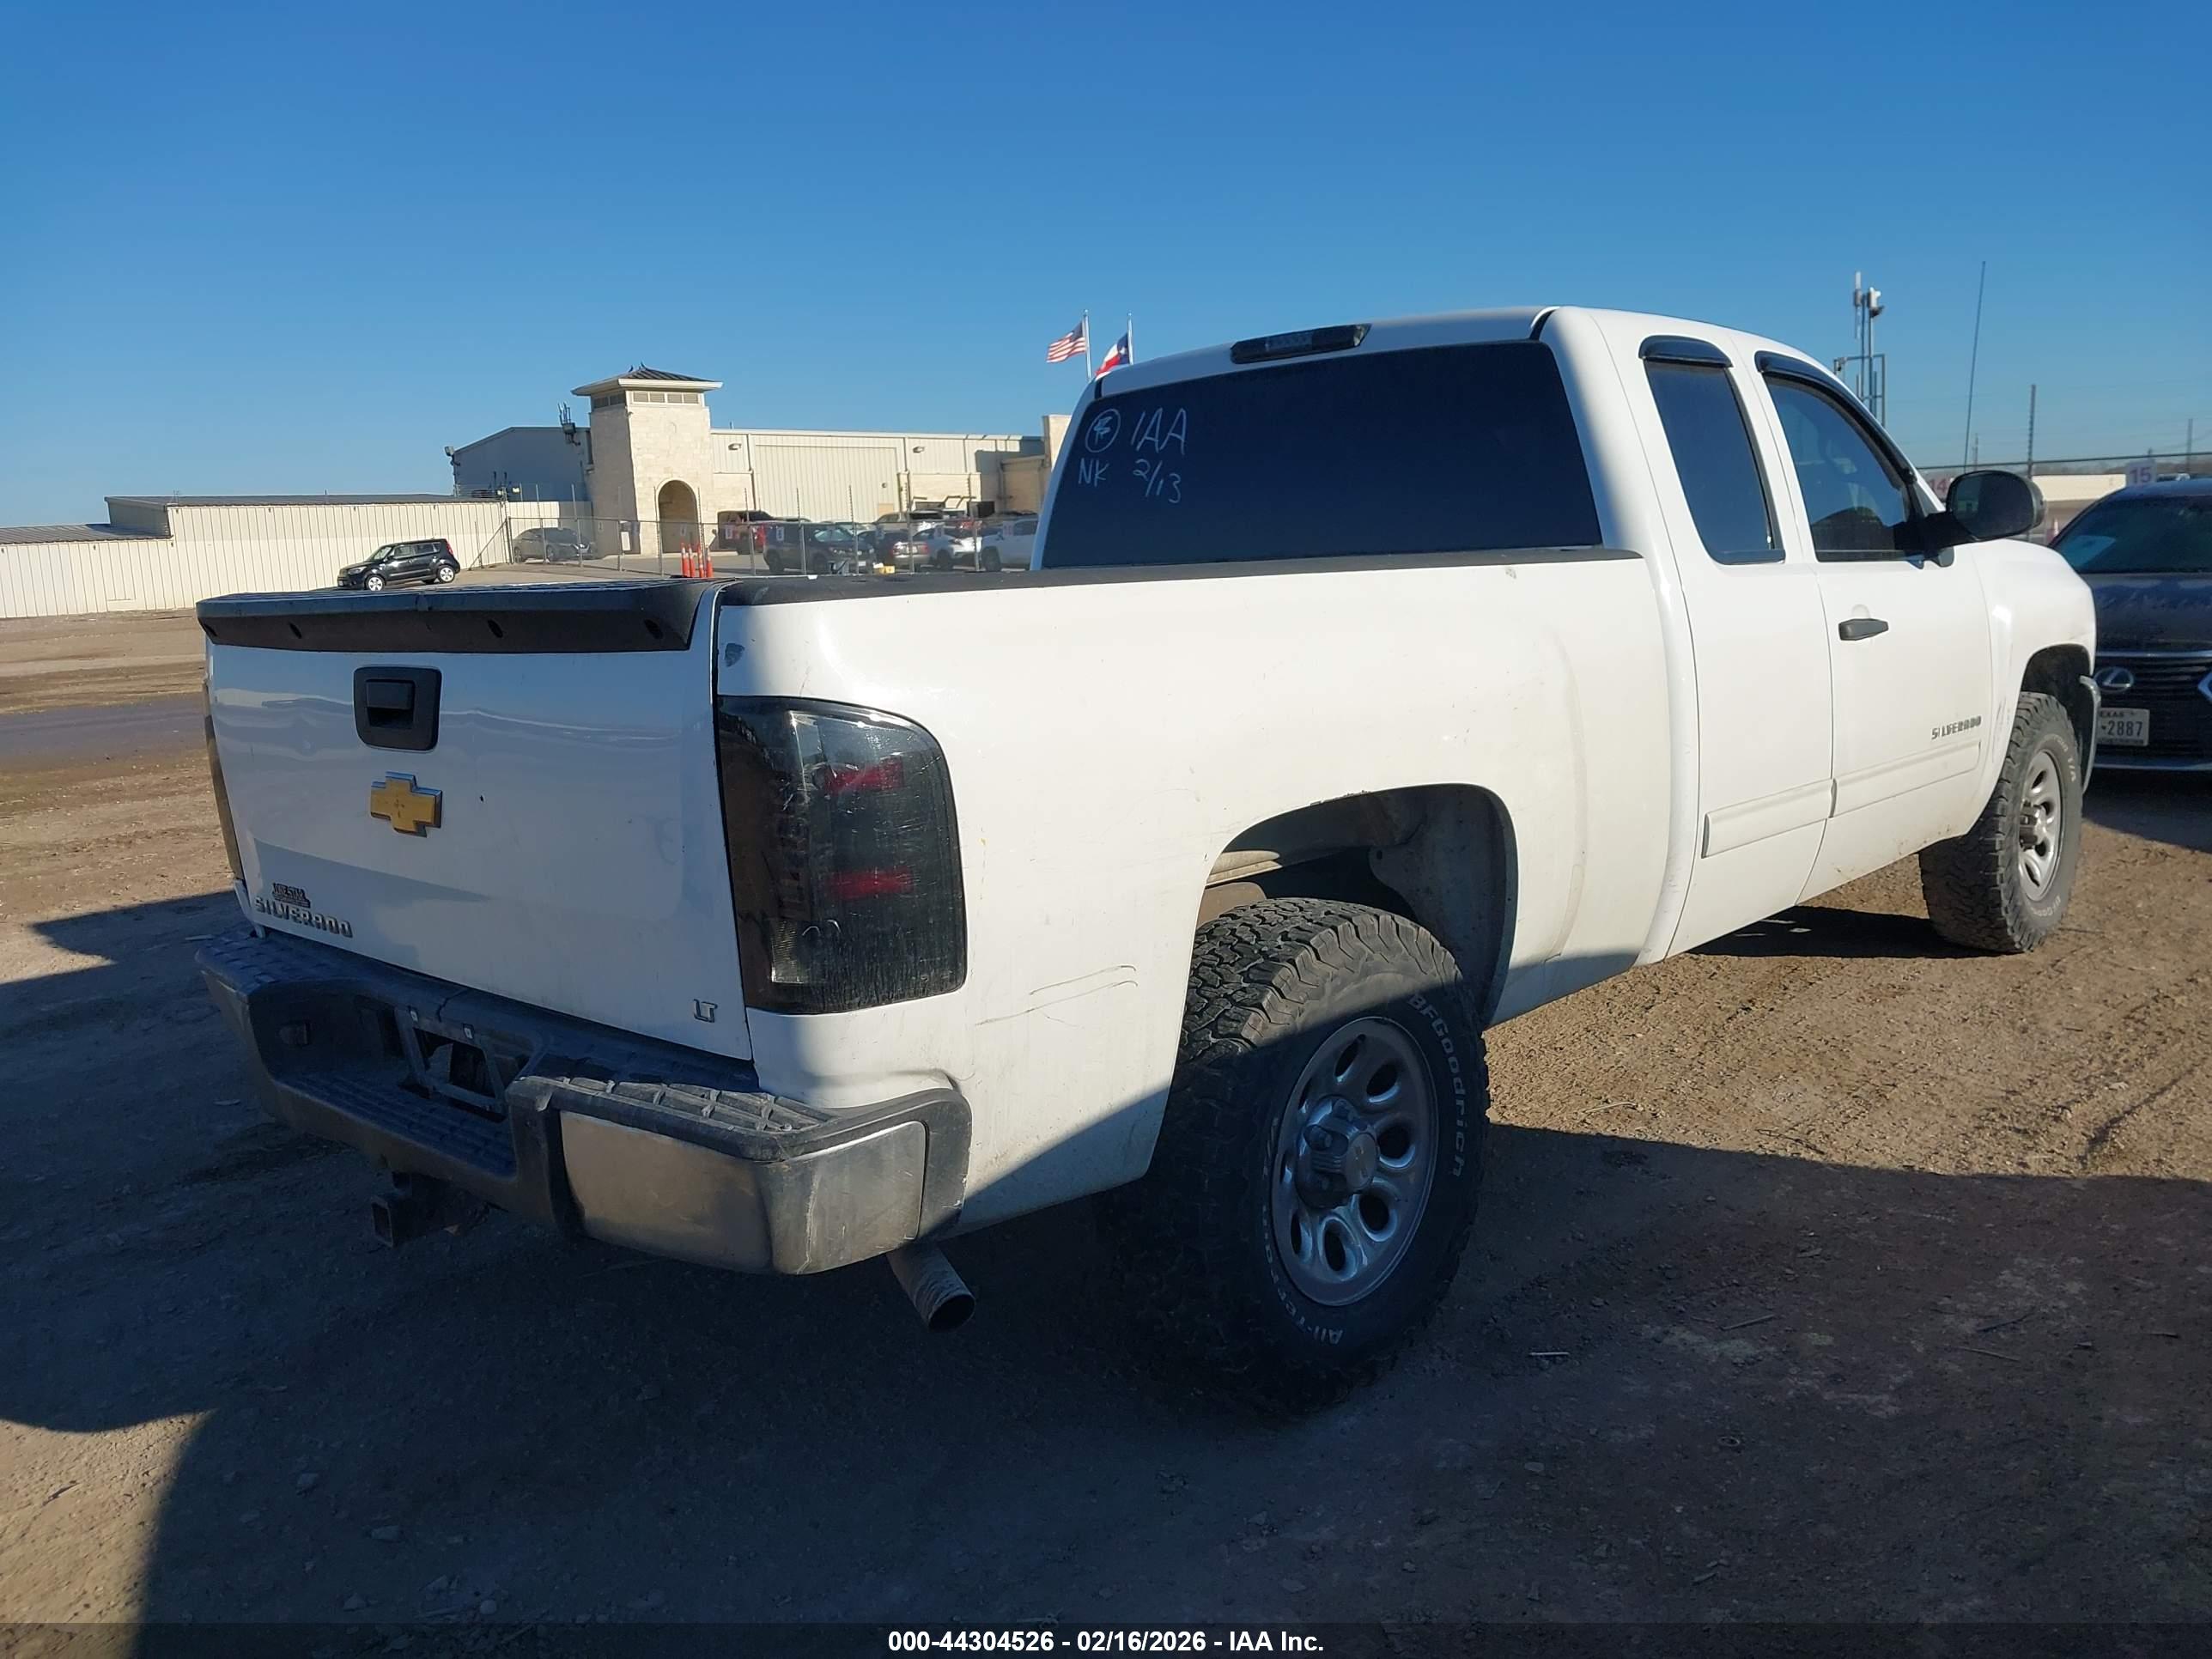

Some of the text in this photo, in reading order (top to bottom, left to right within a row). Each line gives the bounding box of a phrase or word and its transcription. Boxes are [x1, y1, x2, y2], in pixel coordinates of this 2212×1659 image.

[1130, 407, 1188, 455] IAA
[1133, 458, 1182, 503] 2/13
[2130, 466, 2151, 484] 15
[1930, 715, 1982, 740] SILVERADO
[2107, 720, 2143, 737] 2887
[256, 896, 353, 938] SILVERADO
[692, 998, 718, 1023] LT
[1408, 993, 1467, 1178] BFGoodrich
